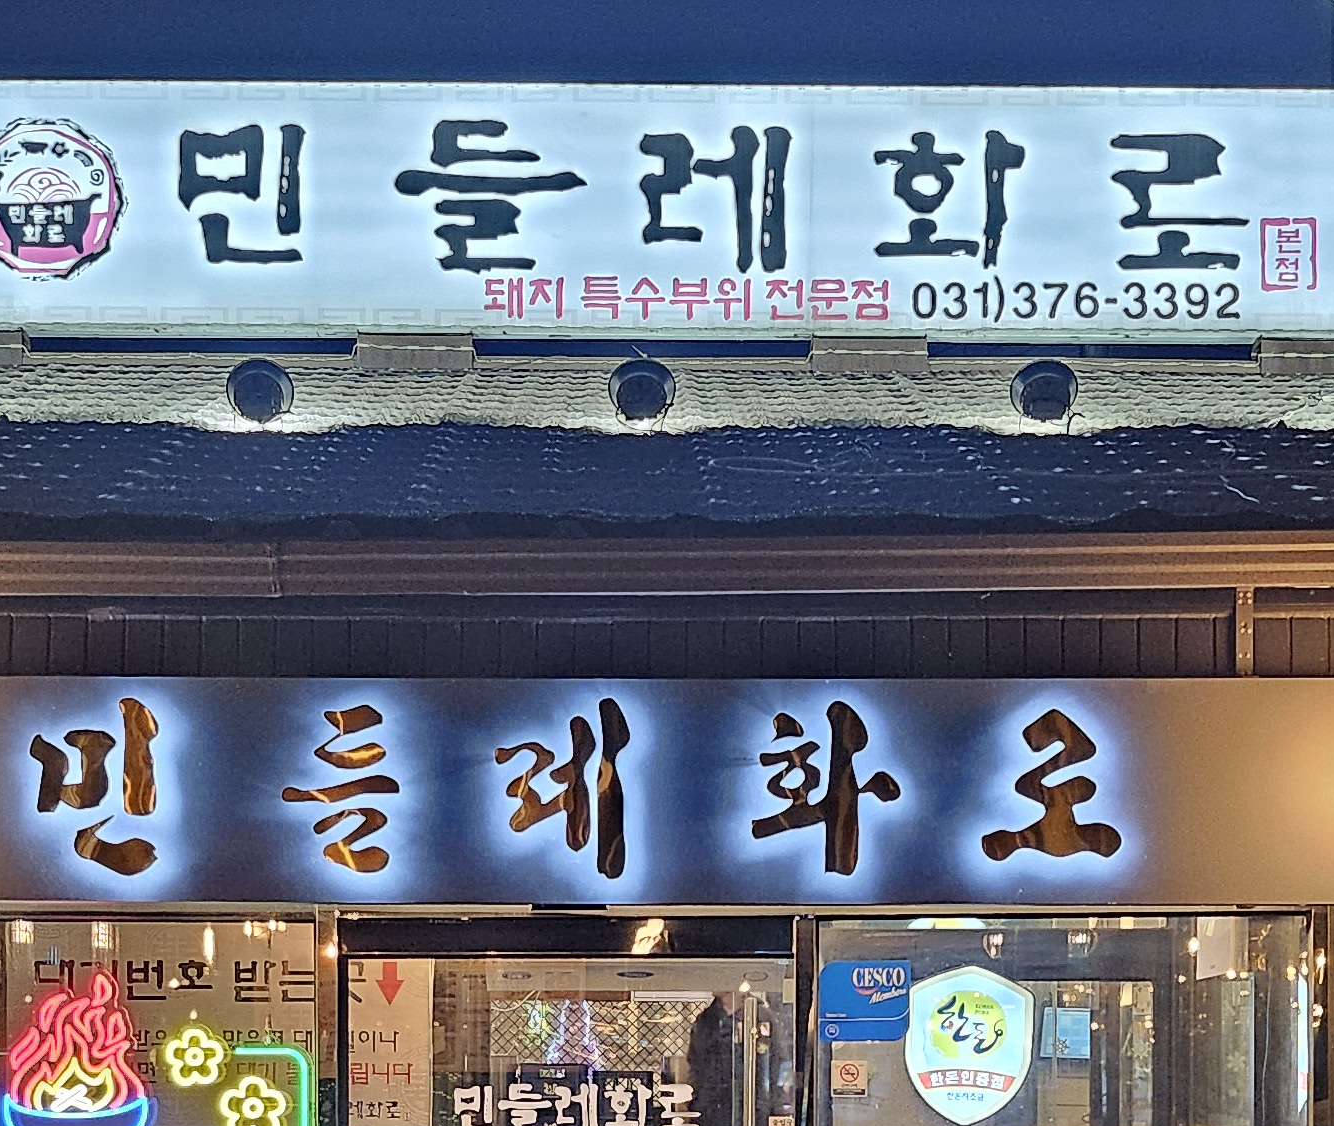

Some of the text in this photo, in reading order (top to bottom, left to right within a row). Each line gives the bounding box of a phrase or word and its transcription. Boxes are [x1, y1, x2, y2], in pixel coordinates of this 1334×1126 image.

[8, 204, 74, 225] 민들레
[22, 224, 65, 243] 화로
[1275, 228, 1302, 284] 본점
[483, 274, 1242, 323] 돼지 특수부위 전문점 031)376-3392
[852, 967, 906, 987] CESCO
